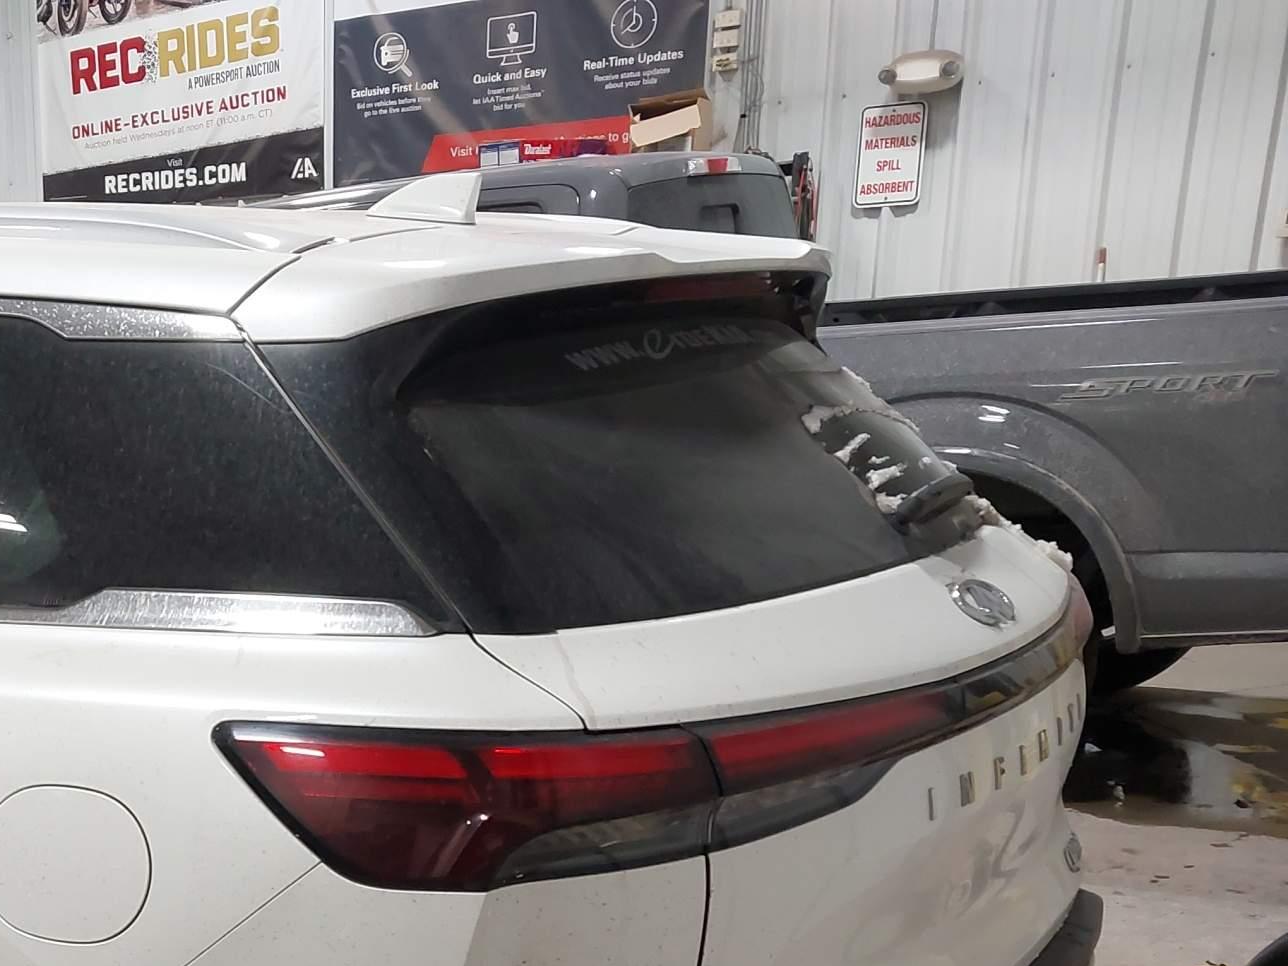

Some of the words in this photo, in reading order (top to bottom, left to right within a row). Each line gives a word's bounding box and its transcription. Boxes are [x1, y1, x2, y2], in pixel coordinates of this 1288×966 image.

[70, 36, 146, 95] REC
[157, 7, 280, 77] RIDES
[583, 56, 634, 71] Real-Time
[637, 50, 684, 64] Updates
[188, 78, 194, 90] A
[194, 66, 244, 88] POWERSPORT
[246, 59, 280, 78] AUCTION
[473, 72, 502, 84] Quick
[503, 69, 522, 80] and
[524, 67, 547, 78] Easy
[351, 85, 390, 98] Exclusive
[392, 83, 412, 93] First
[415, 79, 440, 91] Look
[72, 100, 214, 139] ONLINE-EXCLUSIVE
[219, 86, 287, 112] AUCTION
[864, 112, 921, 128] HAZARDOUS
[608, 132, 619, 142] to
[622, 133, 631, 144] g
[864, 135, 917, 150] MATERIALS
[450, 146, 473, 158] Visit
[167, 158, 183, 167] Visit
[876, 160, 901, 172] SPILL
[104, 162, 247, 194] RECRIDES.COM
[859, 180, 915, 196] ABSORBENT
[1059, 369, 1281, 401] SPORT
